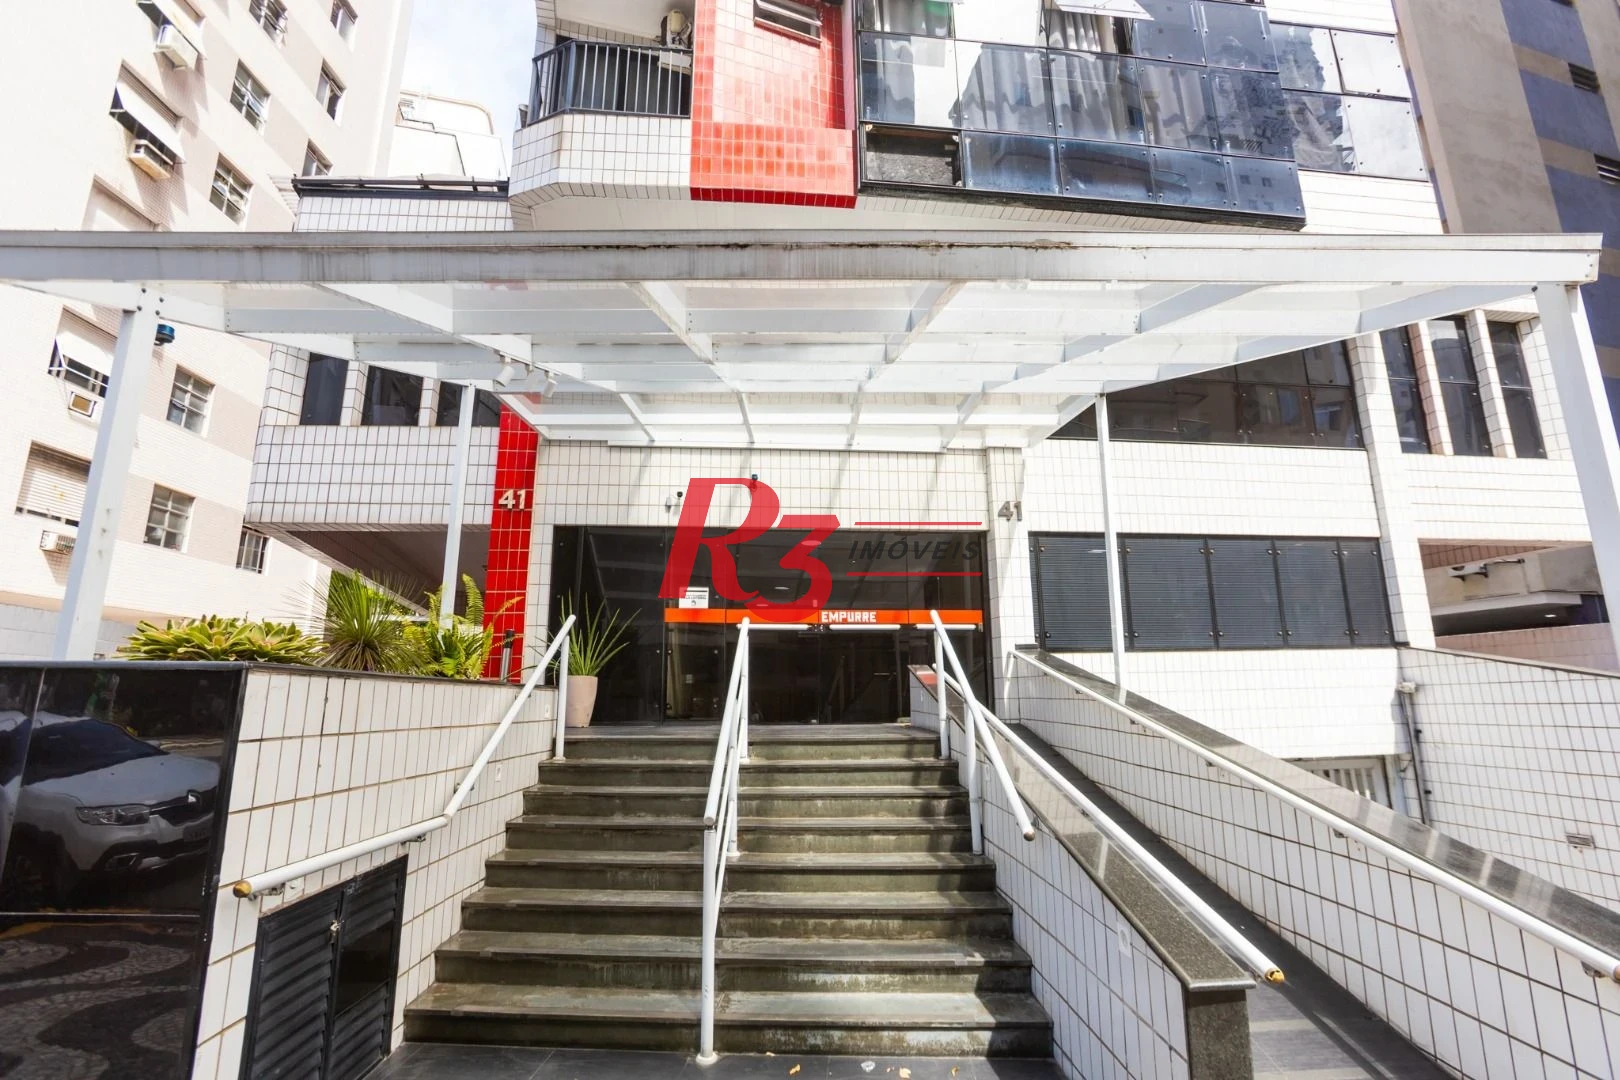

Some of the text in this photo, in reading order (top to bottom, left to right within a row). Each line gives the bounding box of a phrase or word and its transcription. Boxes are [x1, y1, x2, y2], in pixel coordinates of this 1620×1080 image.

[498, 489, 526, 509] 41
[998, 500, 1022, 522] 41
[821, 611, 877, 623] EMPURRE
